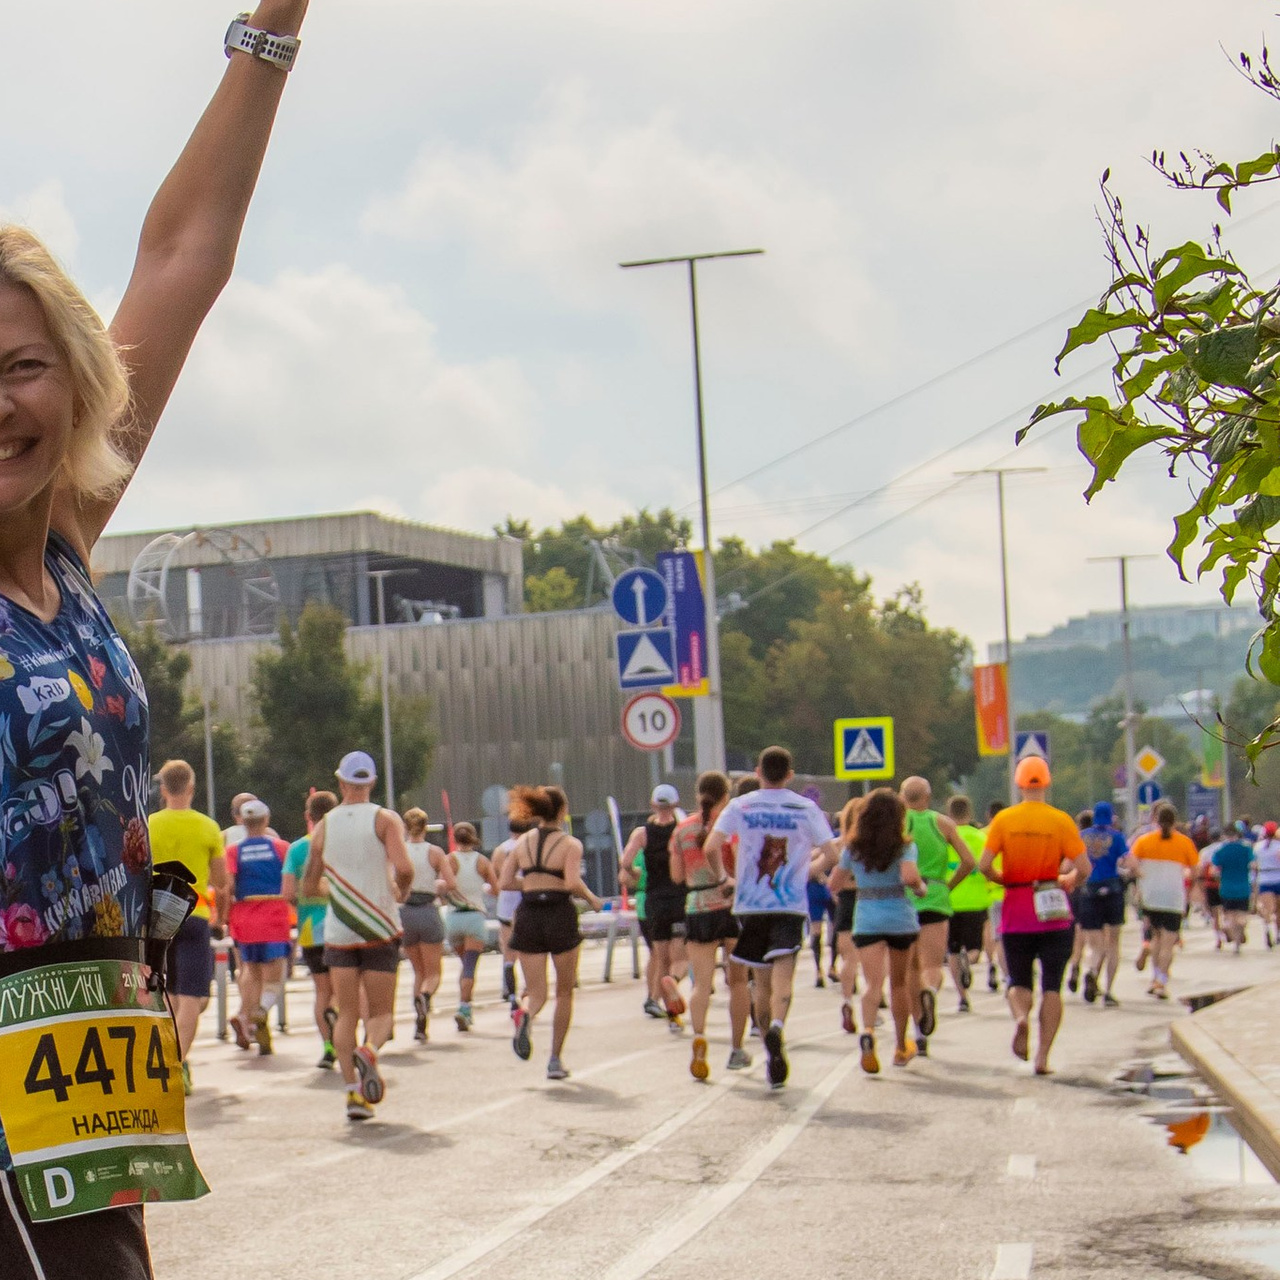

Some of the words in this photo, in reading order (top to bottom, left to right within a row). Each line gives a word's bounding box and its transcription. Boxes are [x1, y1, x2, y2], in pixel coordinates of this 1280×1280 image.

[638, 709, 667, 733] 10
[0, 973, 107, 1023] ЛУЖНИКИ
[23, 1024, 170, 1103] 4474
[72, 1108, 159, 1136] НАДЕЖДА
[42, 1166, 76, 1209] D
